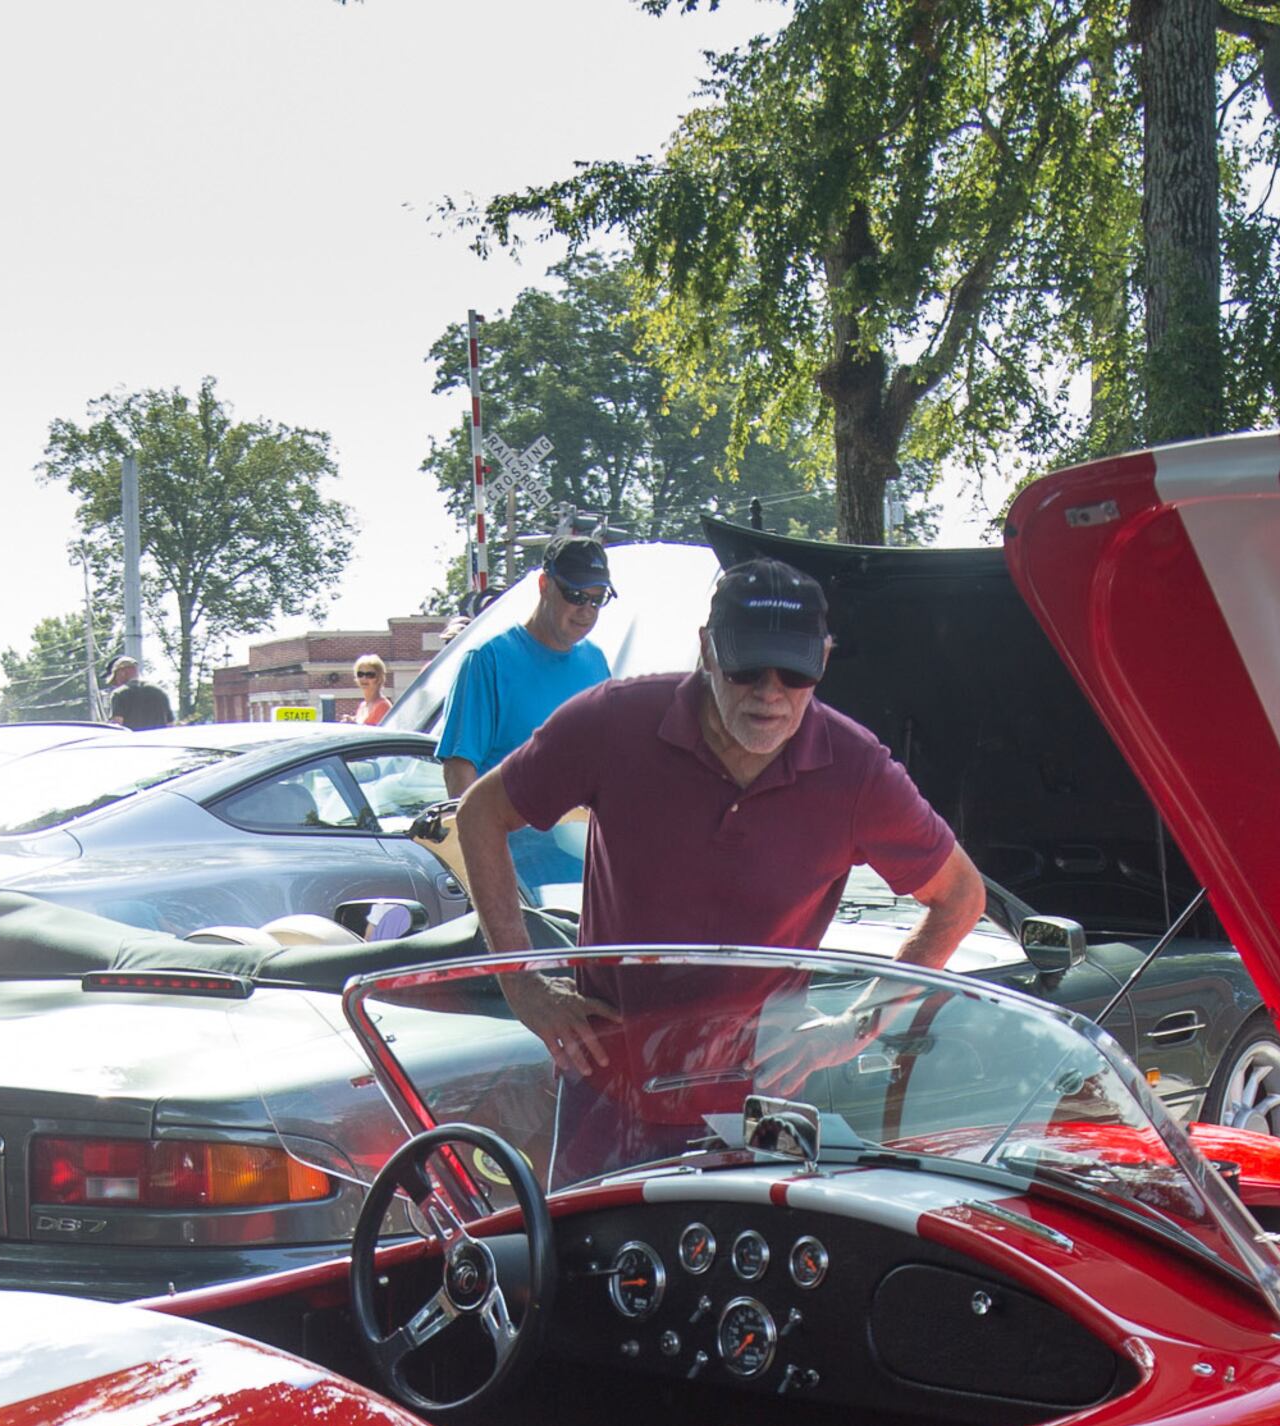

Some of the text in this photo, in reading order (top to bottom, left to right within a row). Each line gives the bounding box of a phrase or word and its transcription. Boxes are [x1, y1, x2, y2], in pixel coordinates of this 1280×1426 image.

[487, 439, 551, 501] CROSSING
[284, 711, 310, 721] STATE
[36, 1216, 108, 1233] DB7
